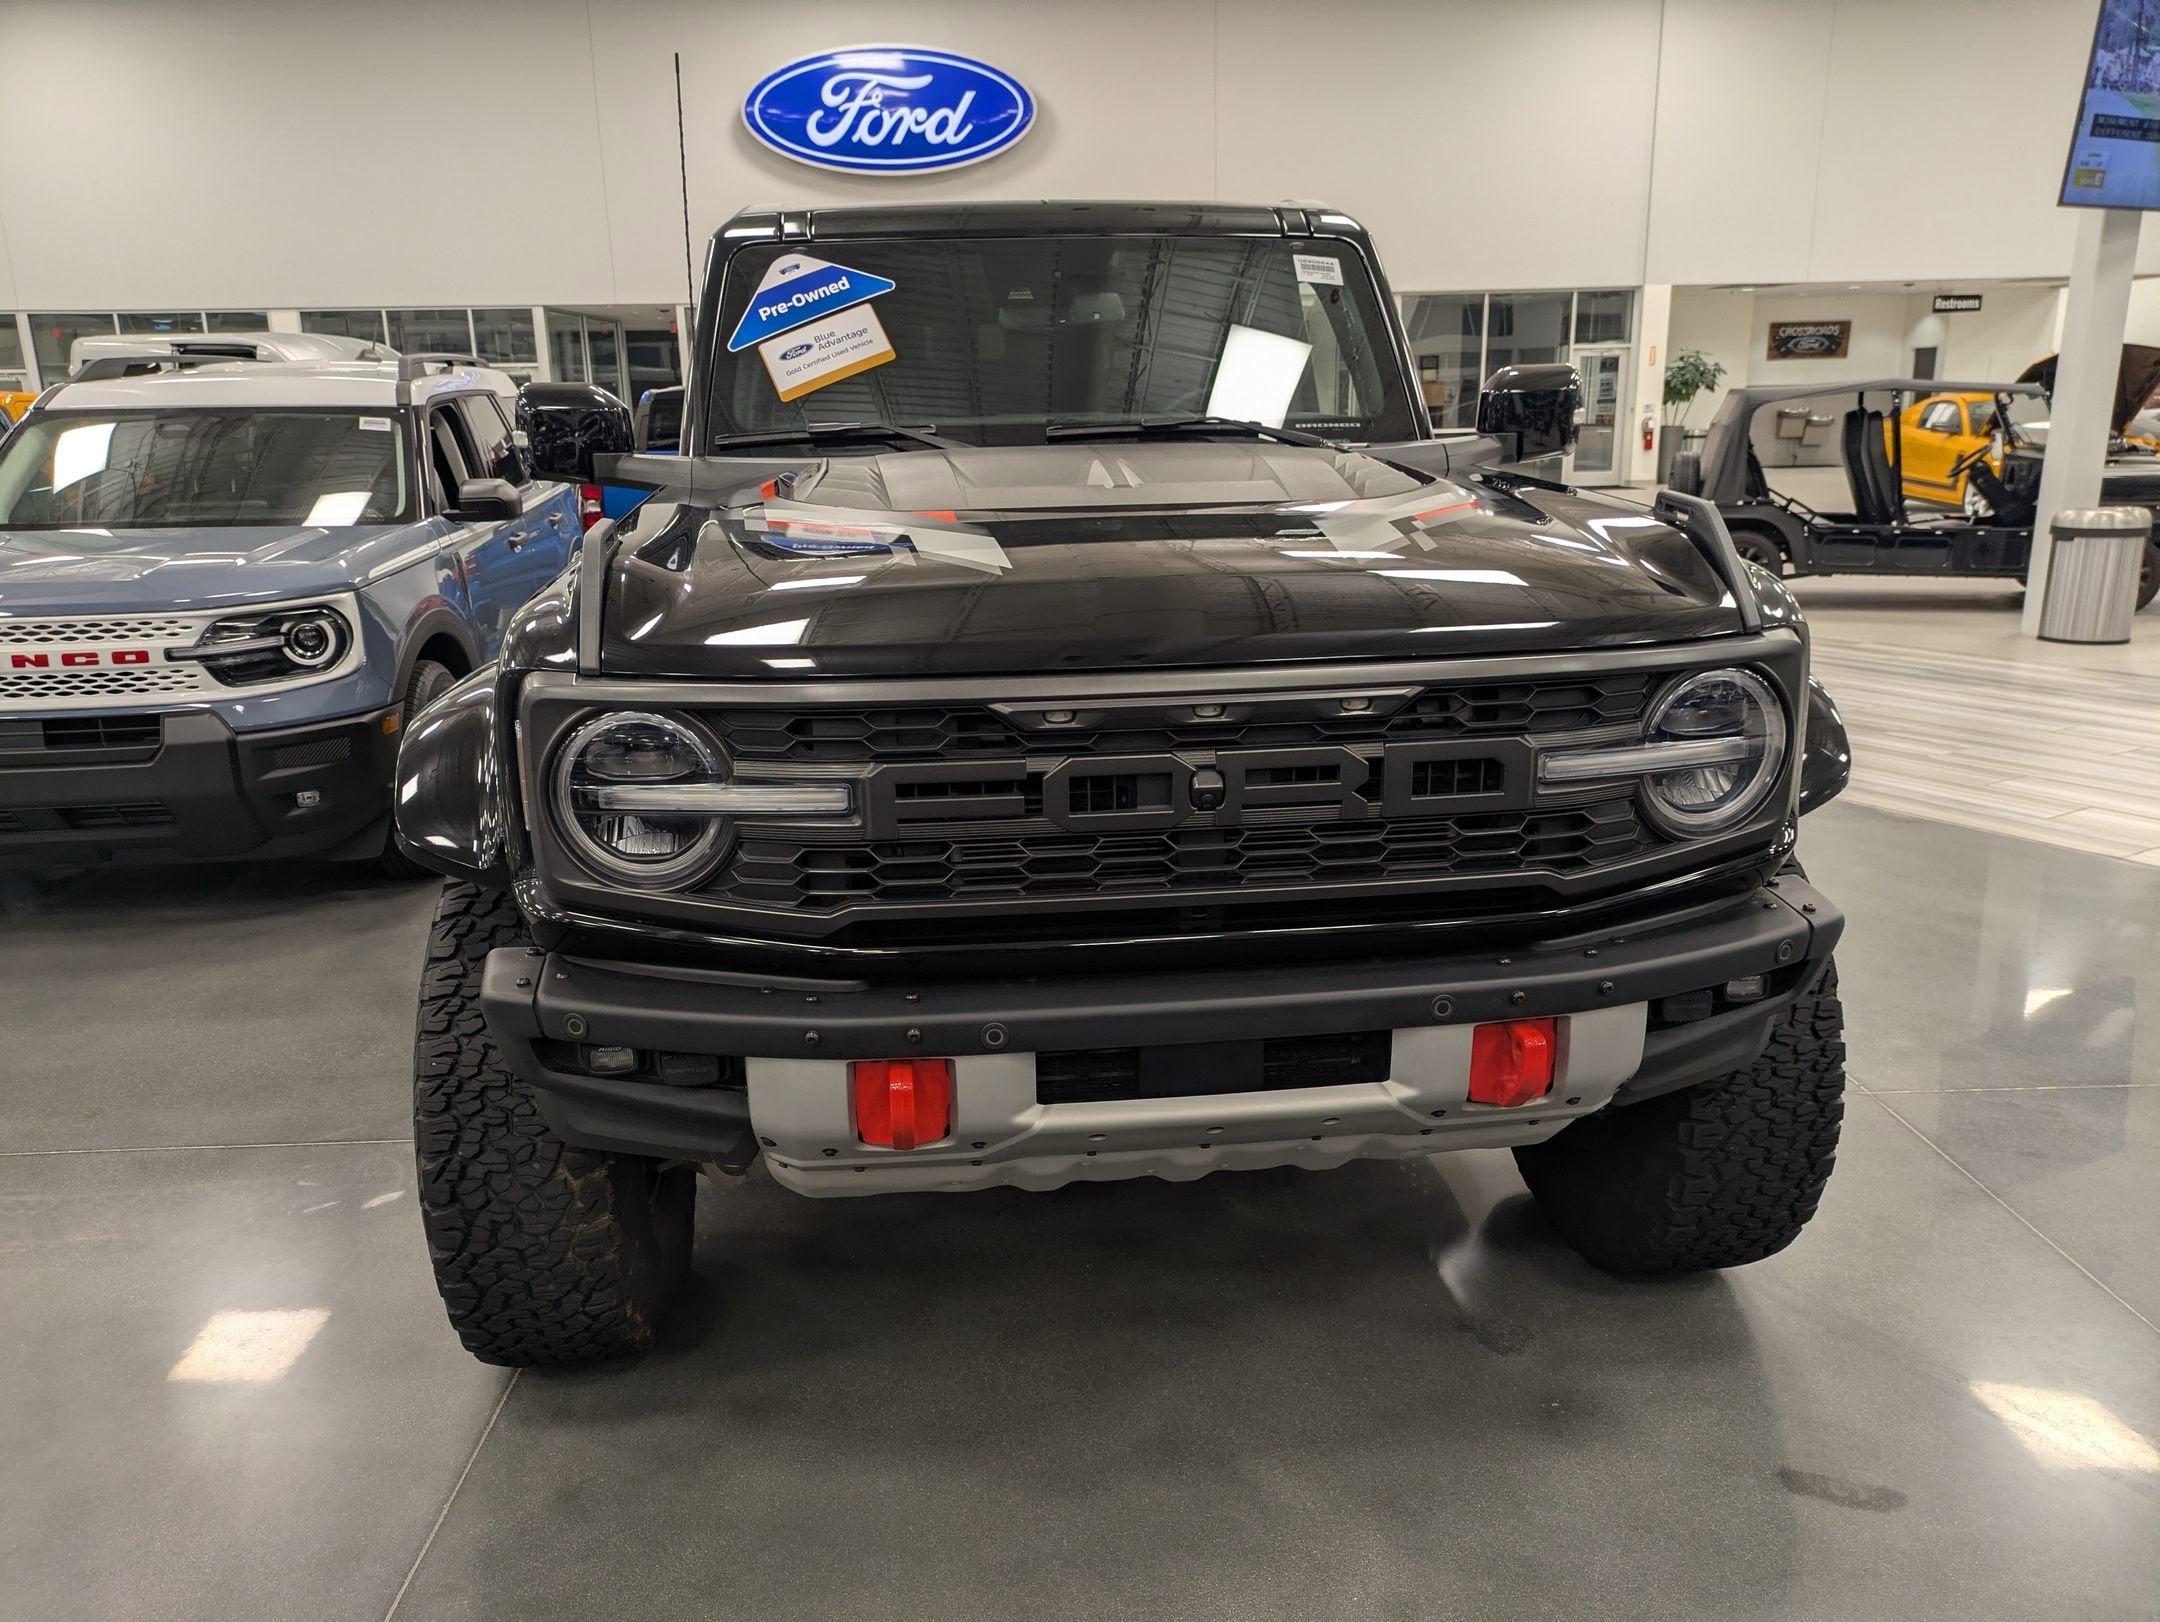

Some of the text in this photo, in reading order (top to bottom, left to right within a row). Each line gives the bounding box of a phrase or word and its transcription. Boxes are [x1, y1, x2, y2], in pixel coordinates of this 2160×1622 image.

[806, 72, 976, 147] Ford
[758, 276, 850, 322] Pre-Owned
[1935, 297, 1980, 310] Restrooms
[813, 330, 836, 344] Blue
[817, 326, 868, 351] Advantage
[1779, 325, 1841, 337] CROSSROADS
[785, 344, 808, 359] Ford
[785, 338, 874, 377] Gold Certified Used Vehicle
[868, 735, 1536, 840] FORD
